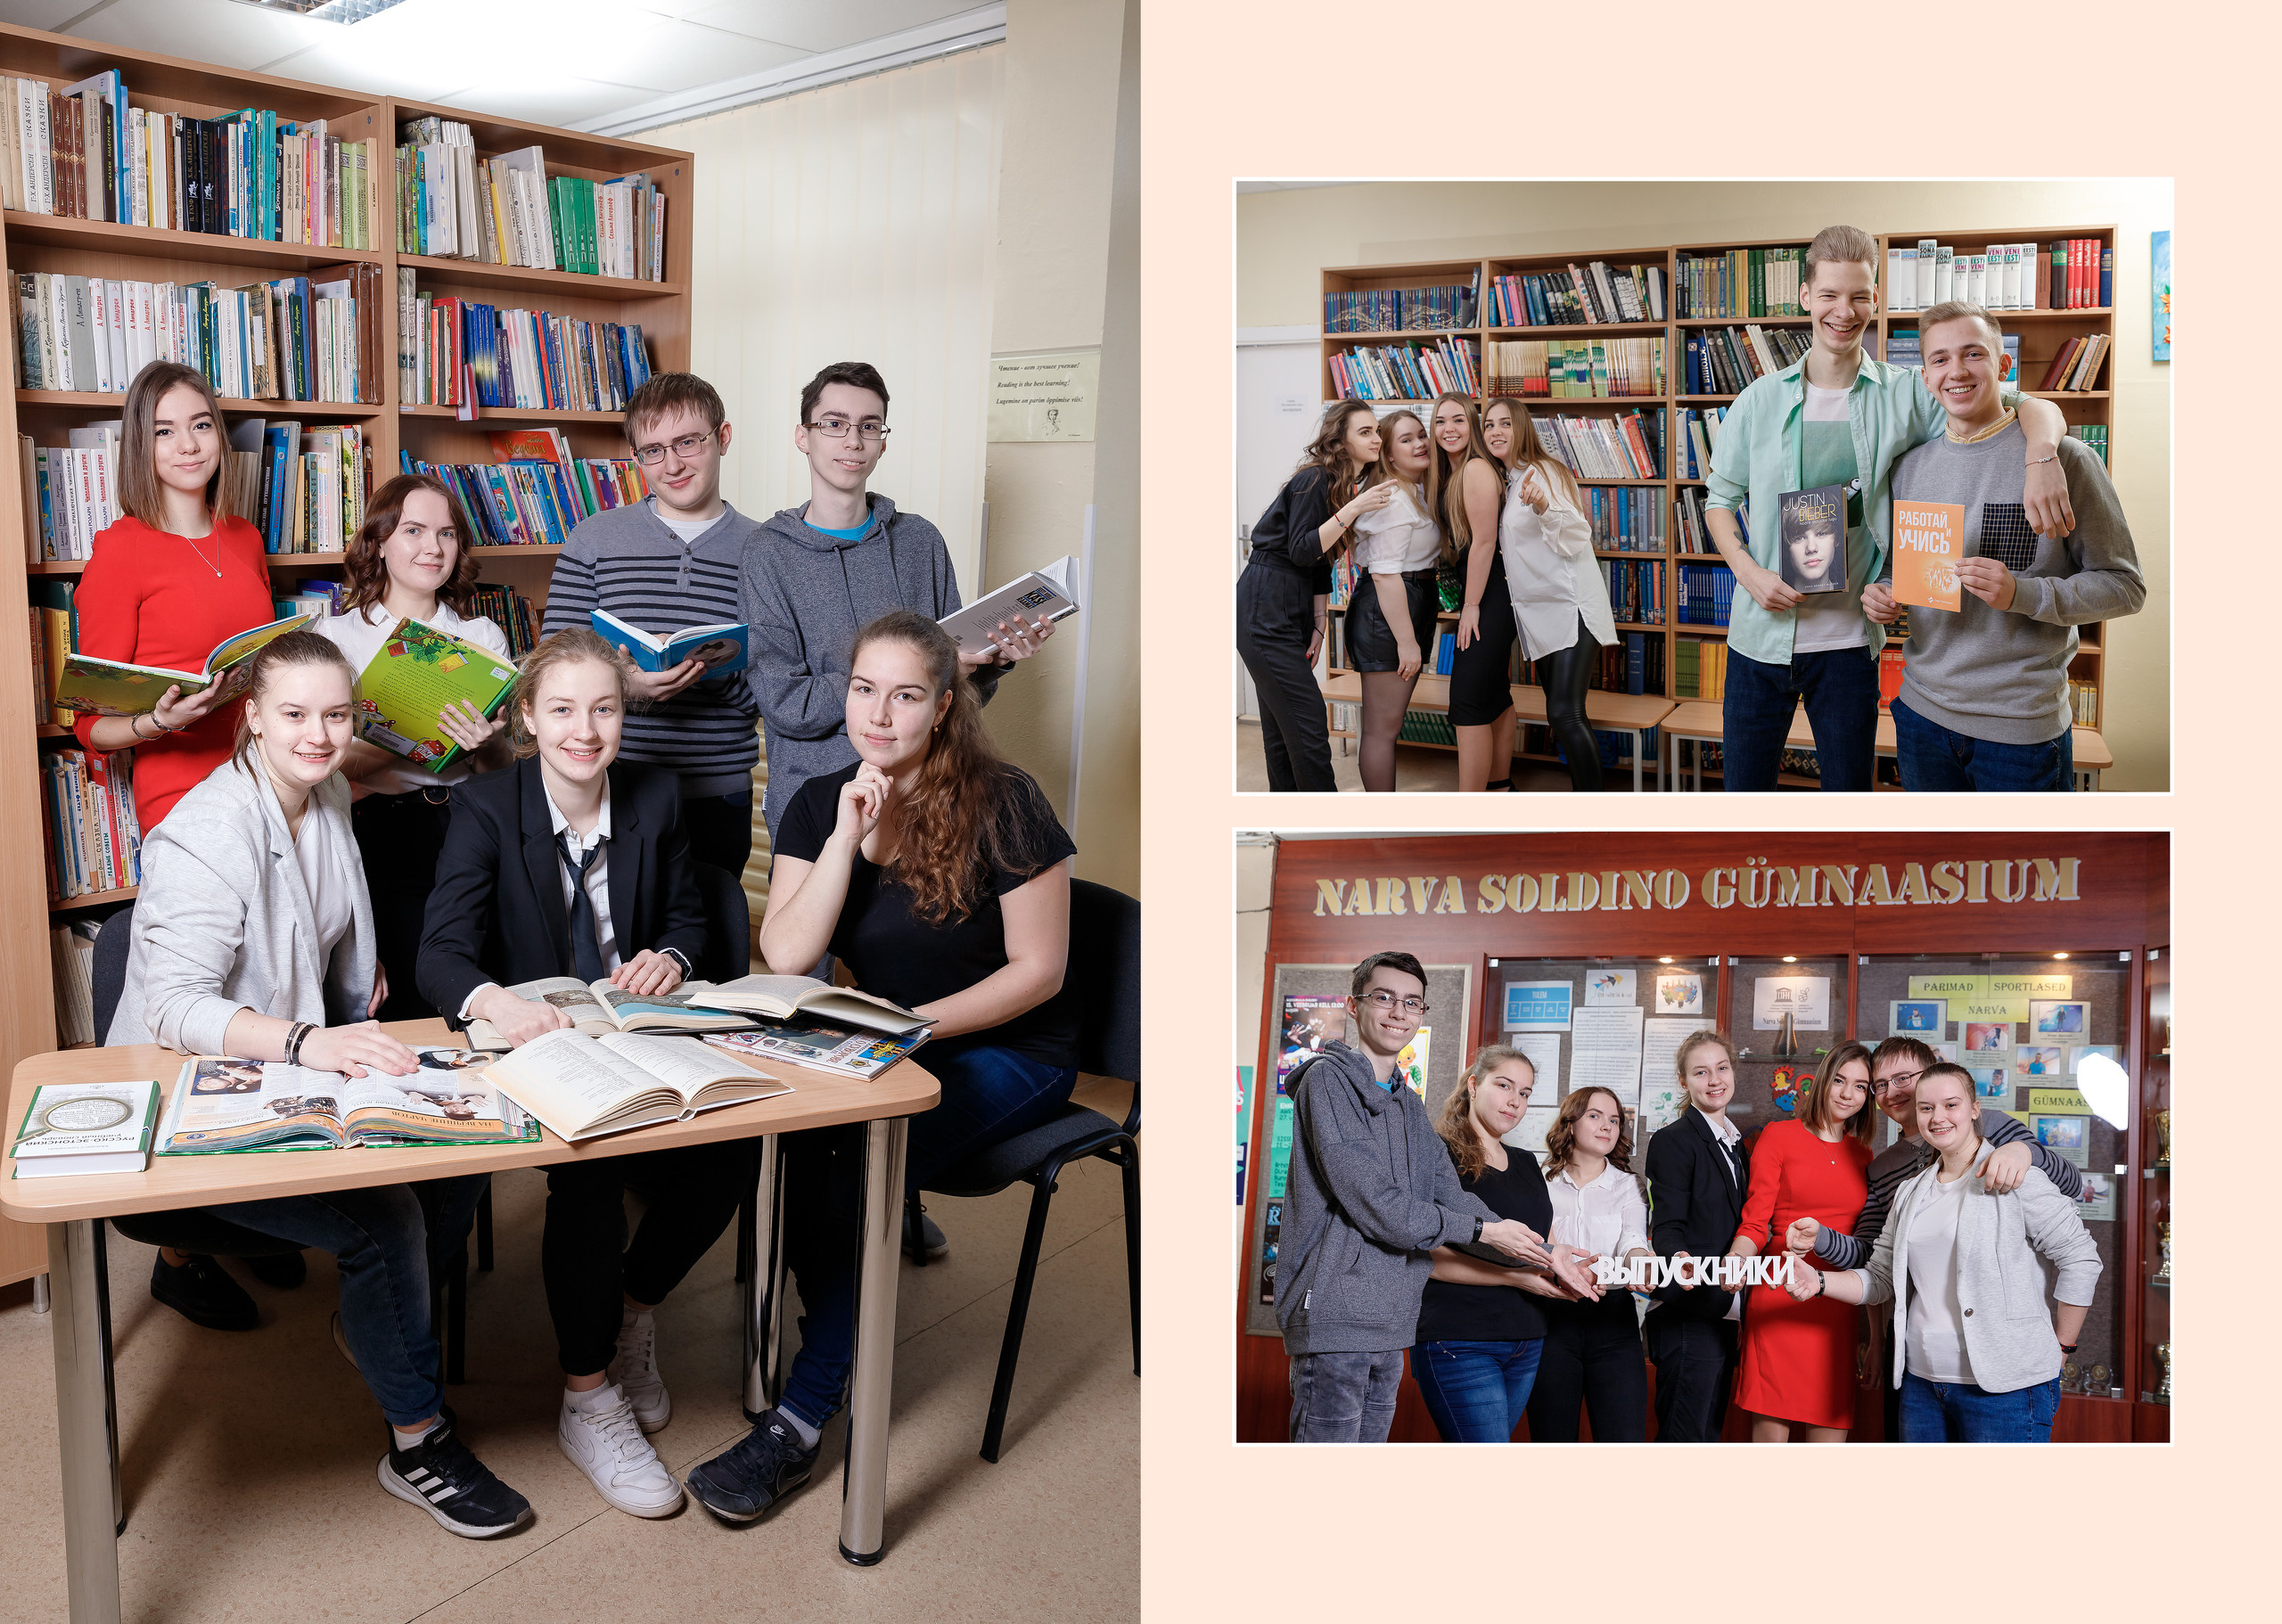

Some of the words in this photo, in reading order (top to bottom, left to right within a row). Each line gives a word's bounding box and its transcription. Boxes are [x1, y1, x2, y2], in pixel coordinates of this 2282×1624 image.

[24, 97, 33, 138] СКАЗКИ
[39, 99, 47, 139] СКАЗКИ
[28, 154, 36, 190] АНДЕРСЕН
[76, 288, 84, 319] Линдгрен
[1057, 362, 1080, 370] учение!
[1700, 346, 1711, 384] ЭСТОНИЯ
[505, 440, 546, 457] Ведьма
[82, 476, 90, 503] Чиполлино
[1783, 492, 1826, 512] JUSTIN
[1799, 503, 1837, 522] BIEBER
[1899, 510, 1948, 529] РАБОТАЙ
[1898, 528, 1950, 554] УЧИСЬ
[1946, 528, 1951, 537] И
[94, 822, 102, 853] СКАЗКА
[1313, 874, 1467, 917] NARVA
[1476, 867, 1691, 915] SOLDINO
[1700, 855, 2081, 909] GÜMNAASIUM
[1532, 991, 1547, 999] TULEM
[1924, 982, 1973, 991] PARIMAD
[1993, 982, 2066, 992] SPORTLASED
[1968, 1005, 2007, 1015] NARVA
[2033, 1095, 2089, 1107] GÜMNAAS
[391, 1111, 427, 1121] ЧАРТОВ
[430, 1118, 476, 1127] ВЕРШИНЕ
[25, 1136, 135, 1147] РУССКО-ЭСТОНСКИЙ
[1595, 1254, 1795, 1288] ВЫПУСКНИКИ
